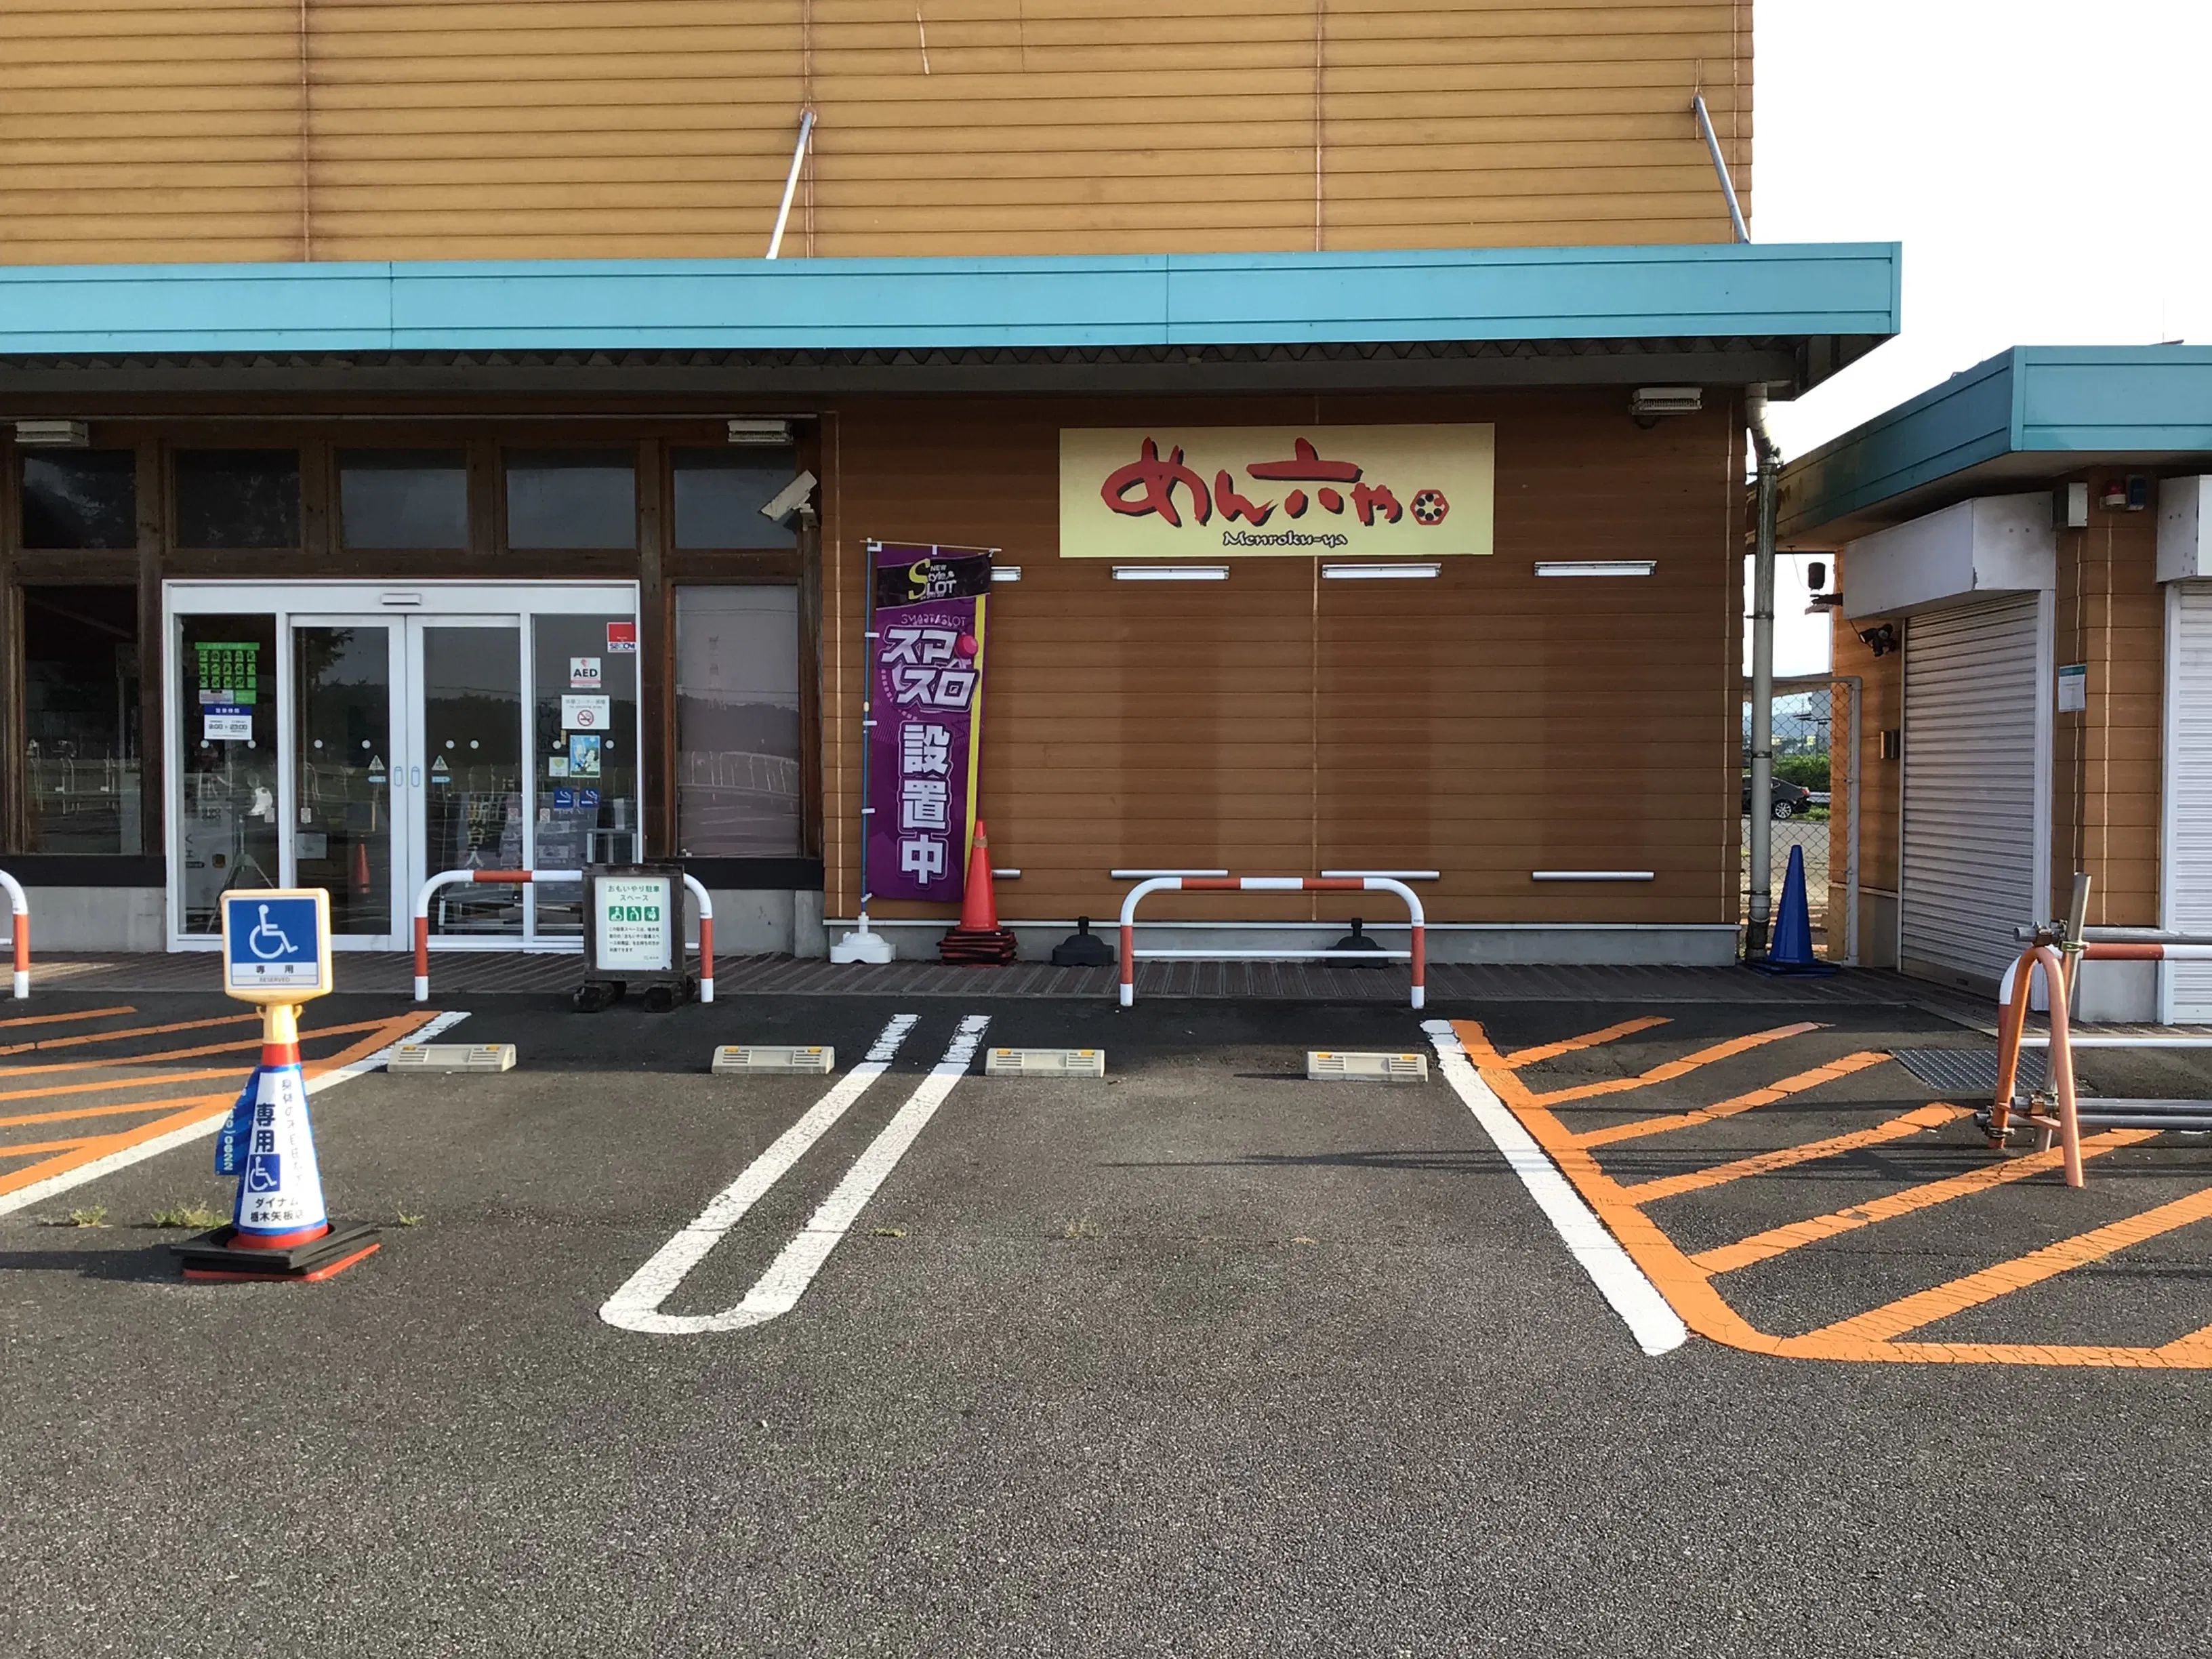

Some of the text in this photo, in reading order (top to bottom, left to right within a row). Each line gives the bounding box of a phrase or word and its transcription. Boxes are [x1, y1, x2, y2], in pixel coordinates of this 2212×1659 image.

[1101, 437, 1402, 527] めん六や
[1222, 530, 1349, 549] Menroku-ya
[573, 669, 598, 678] AED
[902, 724, 949, 884] 設置中
[256, 965, 293, 974] 専用
[254, 1103, 276, 1153] 専用
[255, 1197, 299, 1209] ダイナム
[250, 1210, 304, 1223] 栃木矢板店
